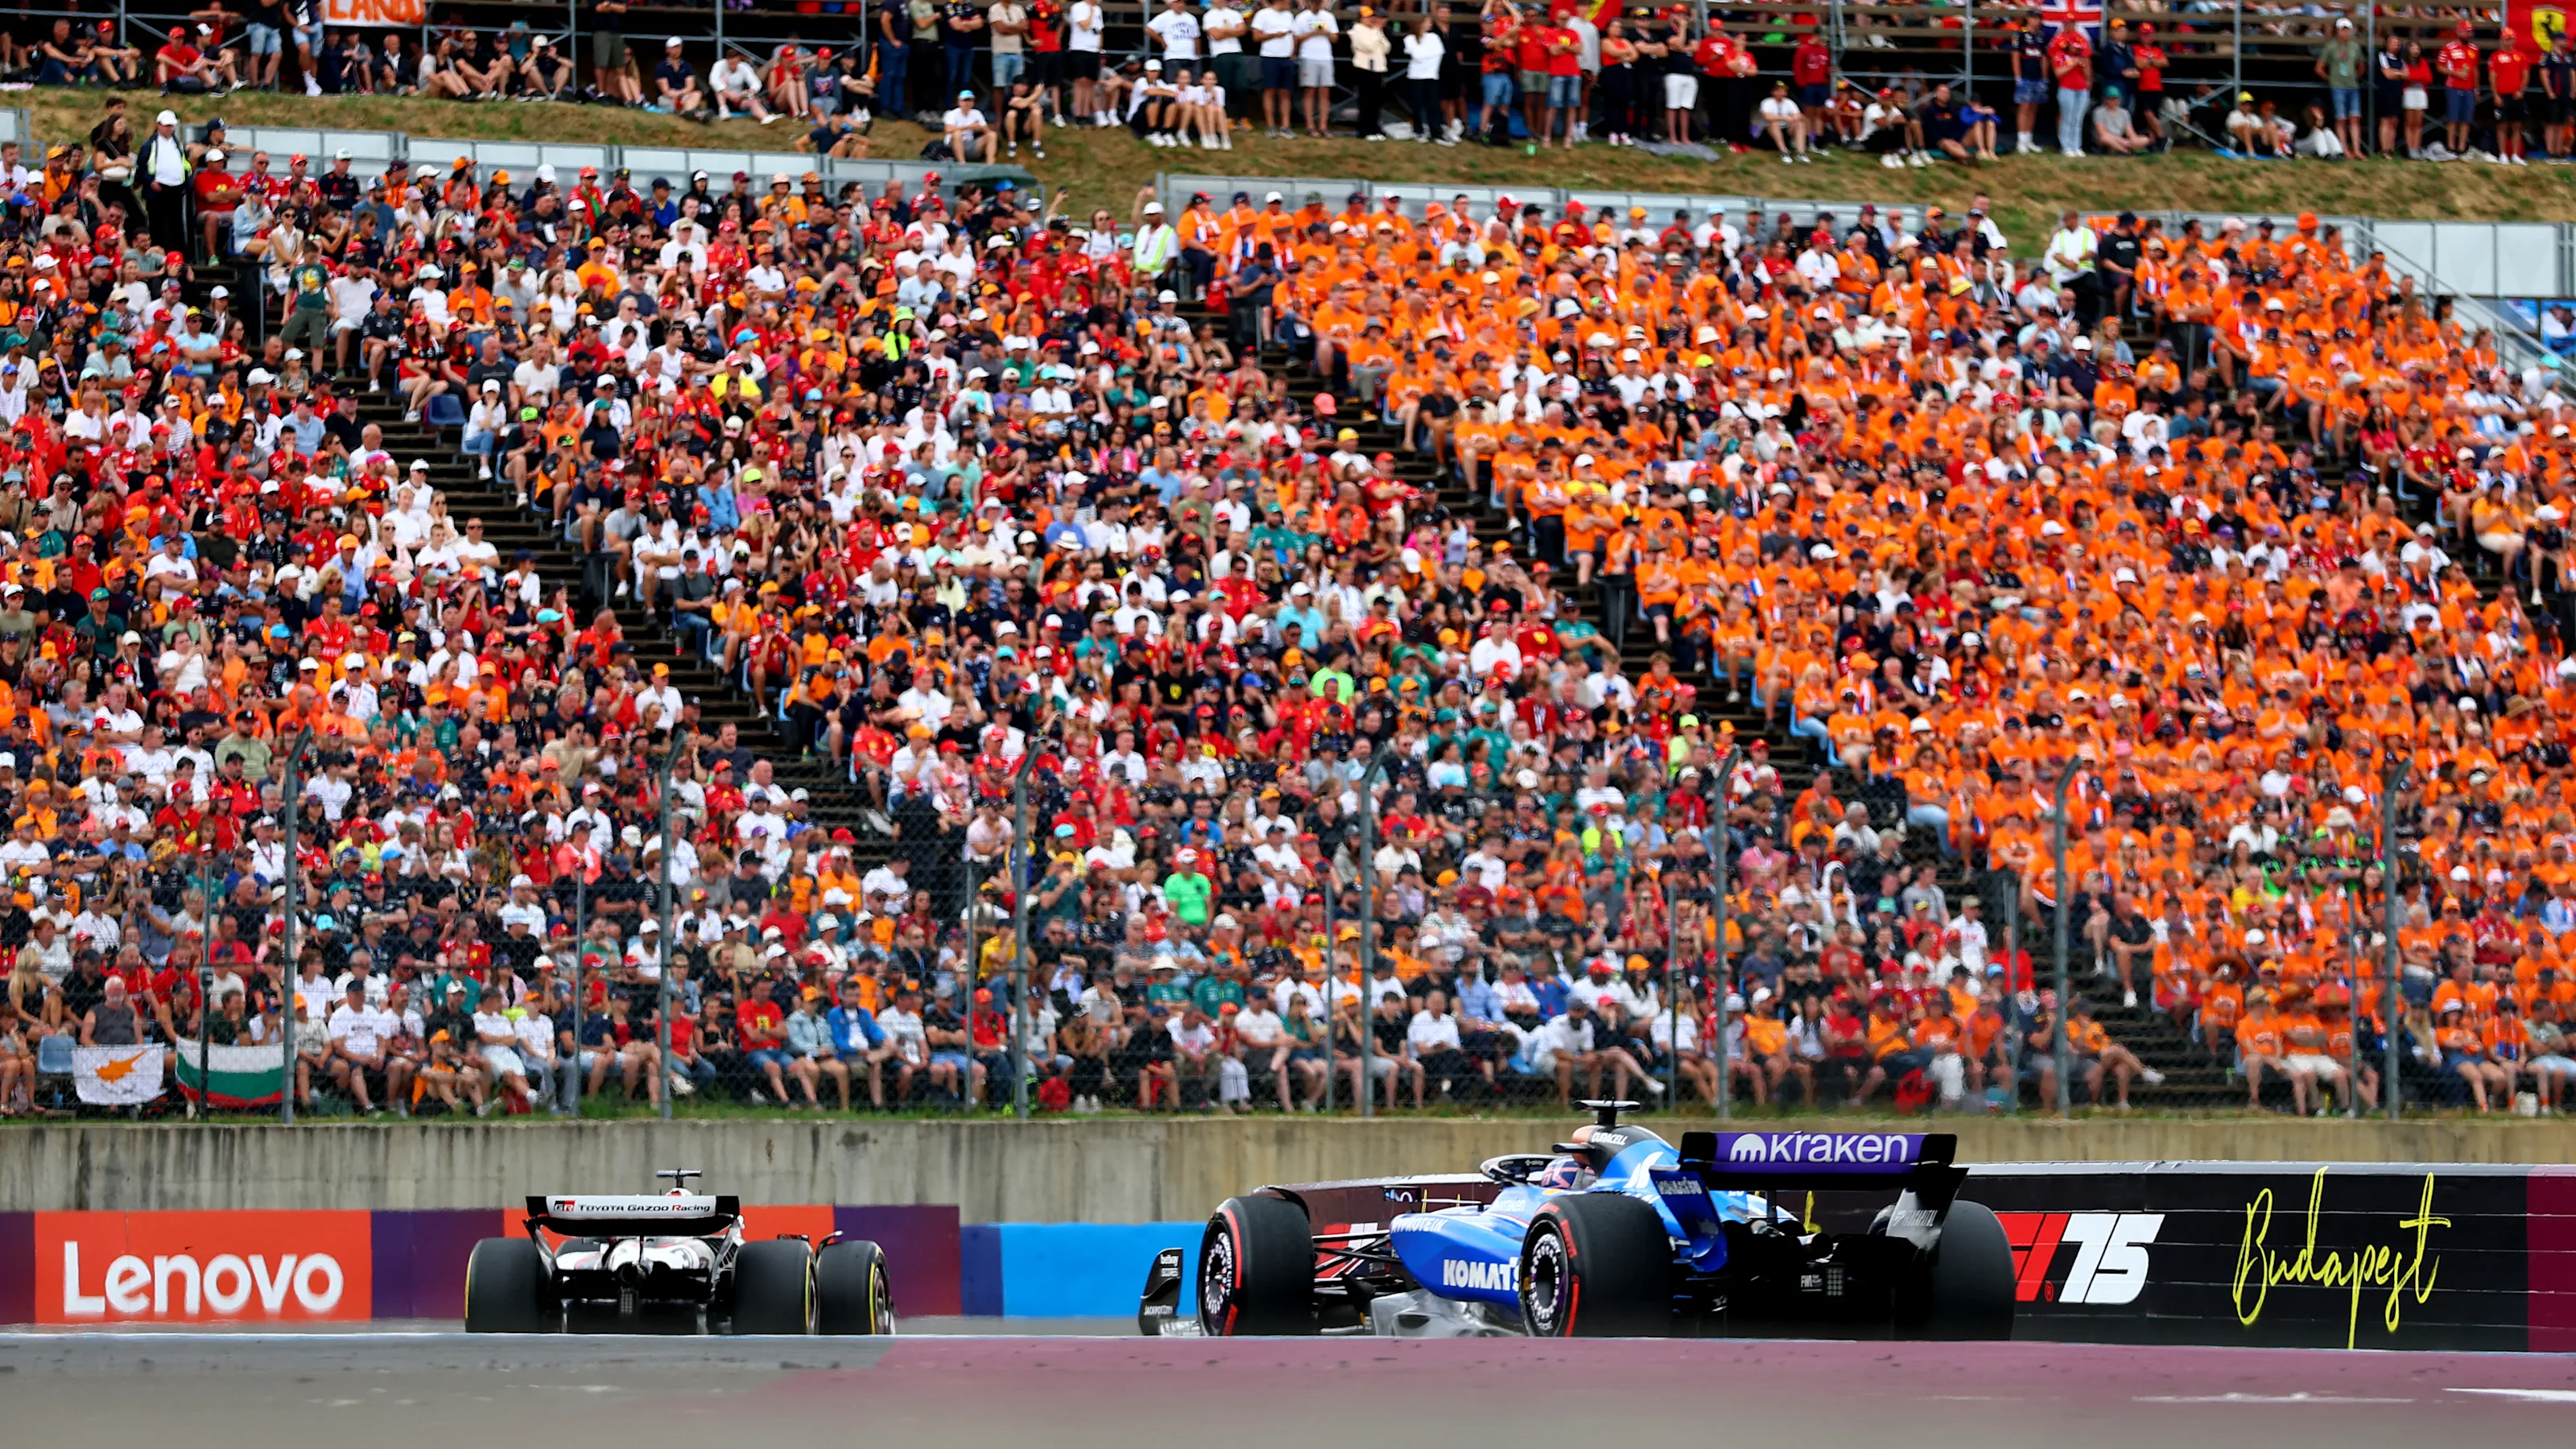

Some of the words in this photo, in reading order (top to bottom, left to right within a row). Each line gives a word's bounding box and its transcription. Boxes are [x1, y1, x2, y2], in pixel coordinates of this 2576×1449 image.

[1591, 1132, 1628, 1146] DURACELL
[671, 1204, 711, 1212] Racing
[64, 1241, 345, 1315] Lenovo
[2058, 1213, 2165, 1304] 75
[2232, 1166, 2451, 1350] Budapest
